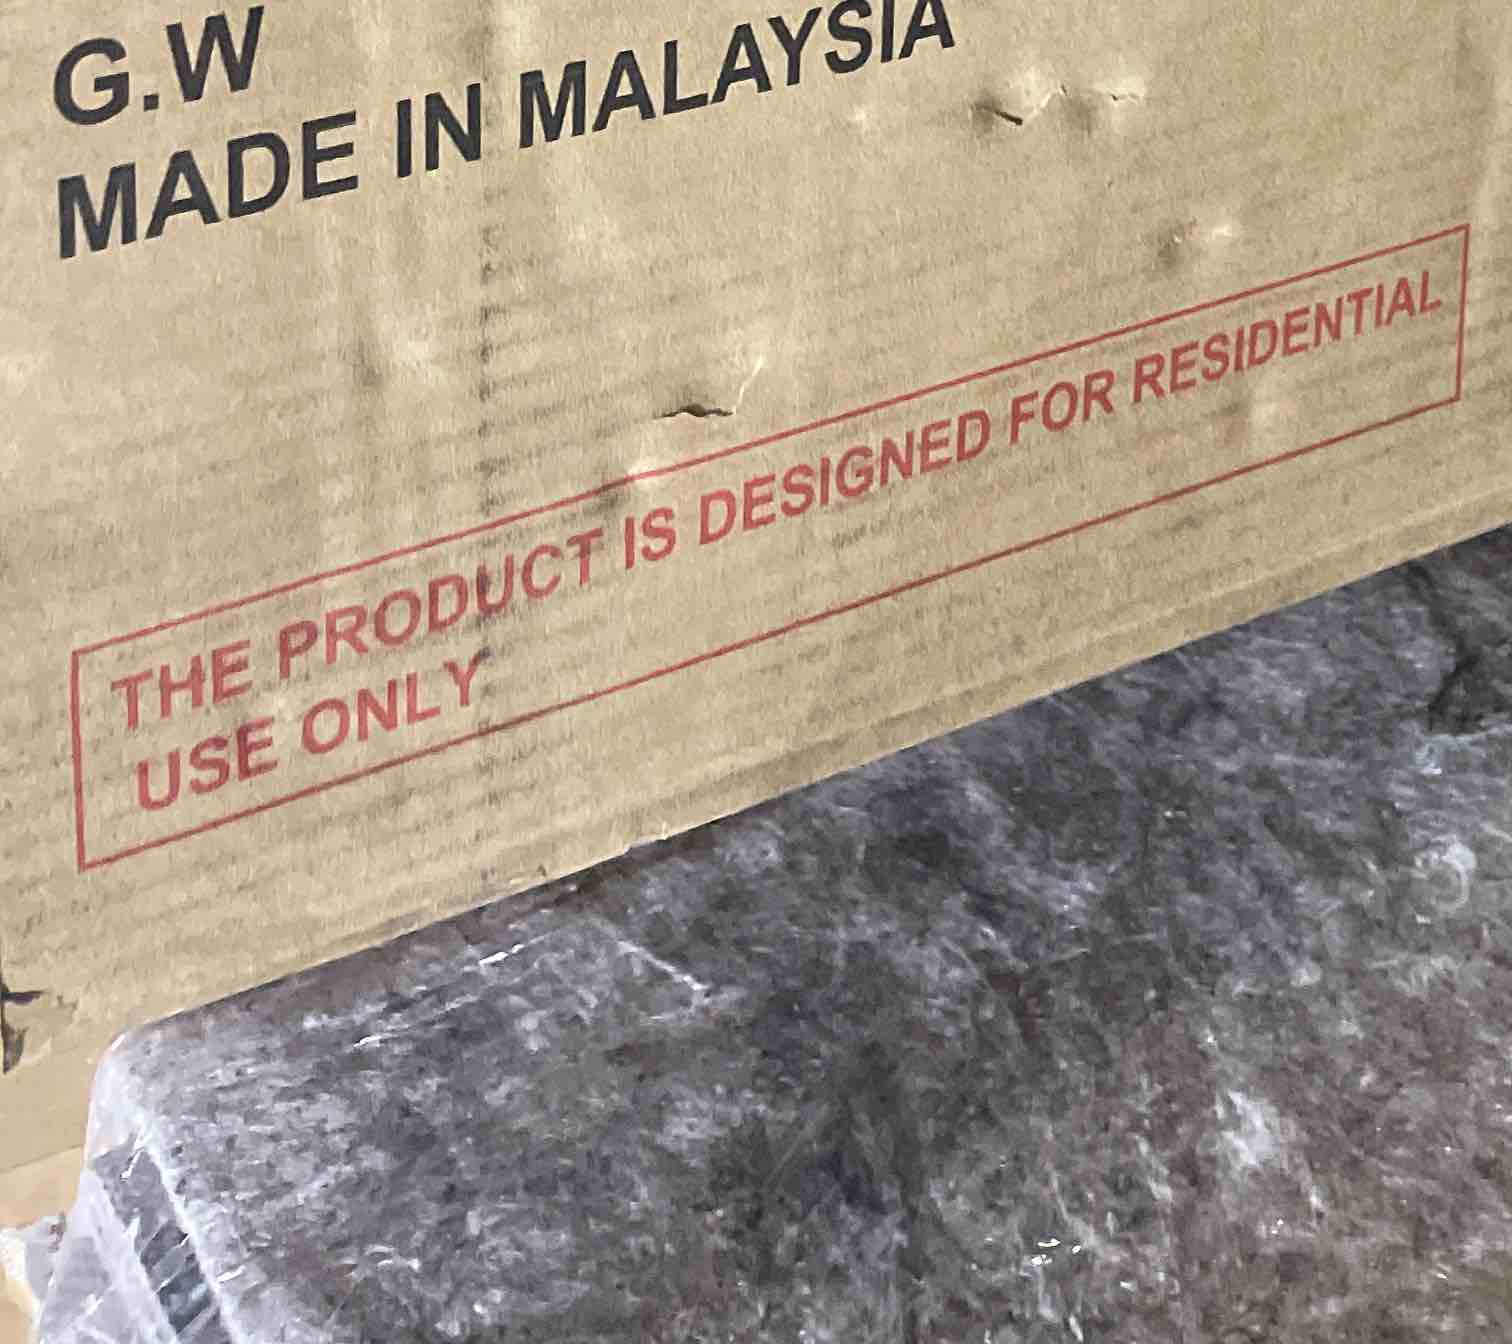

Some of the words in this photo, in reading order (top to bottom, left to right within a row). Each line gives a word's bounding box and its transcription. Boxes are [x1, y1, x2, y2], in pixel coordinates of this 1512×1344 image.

[54, 6, 264, 125] G.W
[58, 110, 358, 259] MADE
[397, 83, 481, 178] IN
[114, 641, 250, 732] THE
[276, 529, 603, 680] PRODUCT
[624, 507, 677, 569] IS
[699, 410, 991, 544] DESIGNED
[1009, 369, 1117, 443] FOR
[1132, 270, 1441, 403] RESIDENTIAL
[136, 732, 276, 812] USE
[300, 649, 483, 755] ONLY
